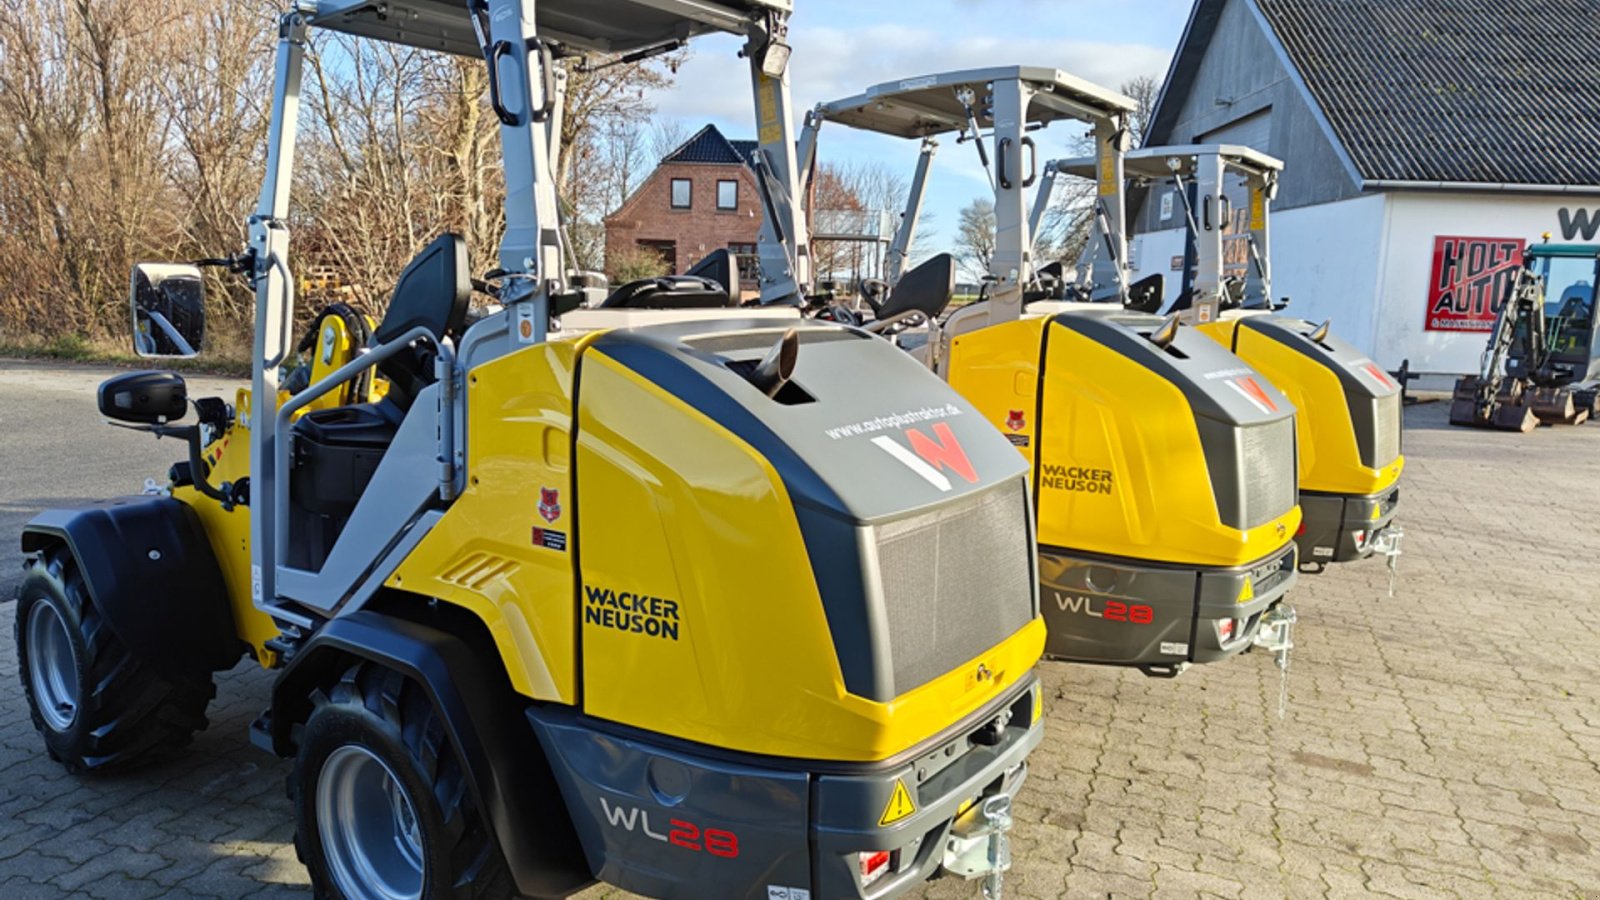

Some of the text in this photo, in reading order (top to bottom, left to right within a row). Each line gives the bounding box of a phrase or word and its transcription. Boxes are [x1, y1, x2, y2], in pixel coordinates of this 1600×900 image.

[1440, 240, 1517, 290] HOLT
[1042, 464, 1113, 482] WACKER
[1042, 476, 1112, 495] NEUSON
[585, 585, 679, 620] WACKER
[1055, 592, 1153, 624] WL28
[585, 605, 679, 641] NEUSON
[600, 797, 739, 858] WL28
